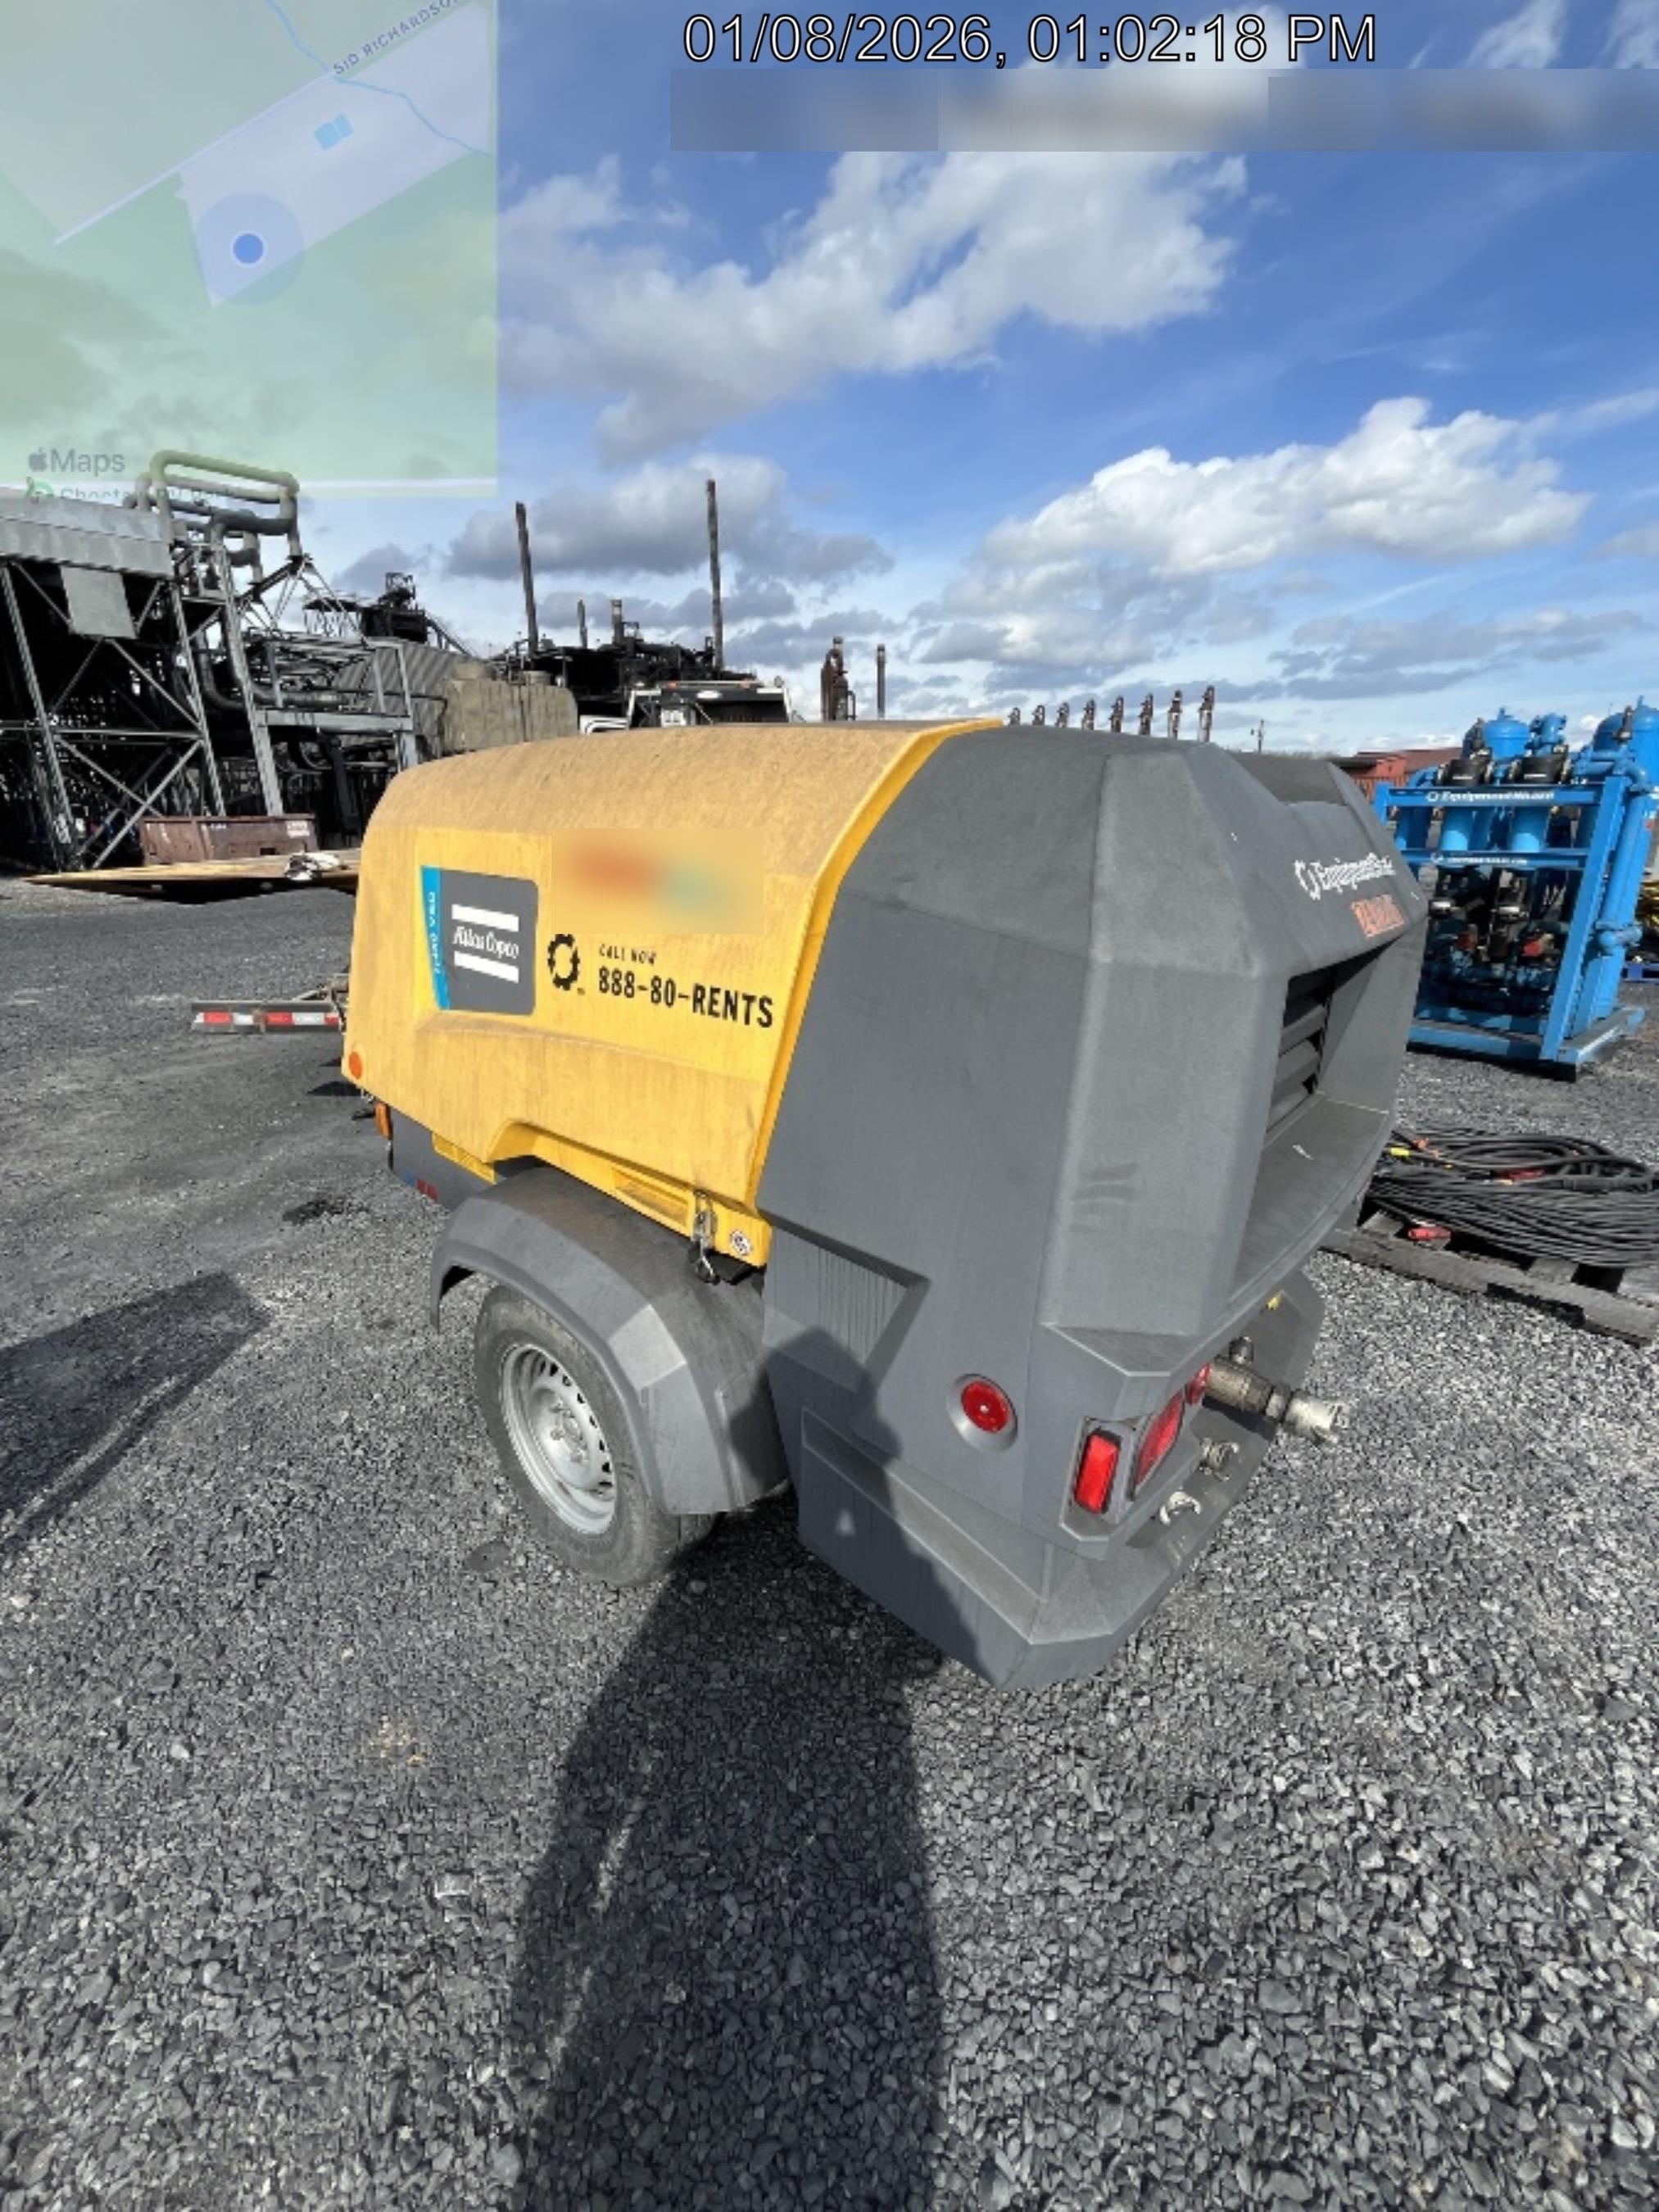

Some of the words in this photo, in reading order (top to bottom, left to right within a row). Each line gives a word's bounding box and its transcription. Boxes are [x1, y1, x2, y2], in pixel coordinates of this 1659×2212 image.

[452, 926, 485, 950] Atlas
[486, 931, 519, 959] Copco
[599, 943, 626, 962] CALL
[630, 948, 657, 966] NOW
[598, 966, 774, 1028] 888-80-RENTS
